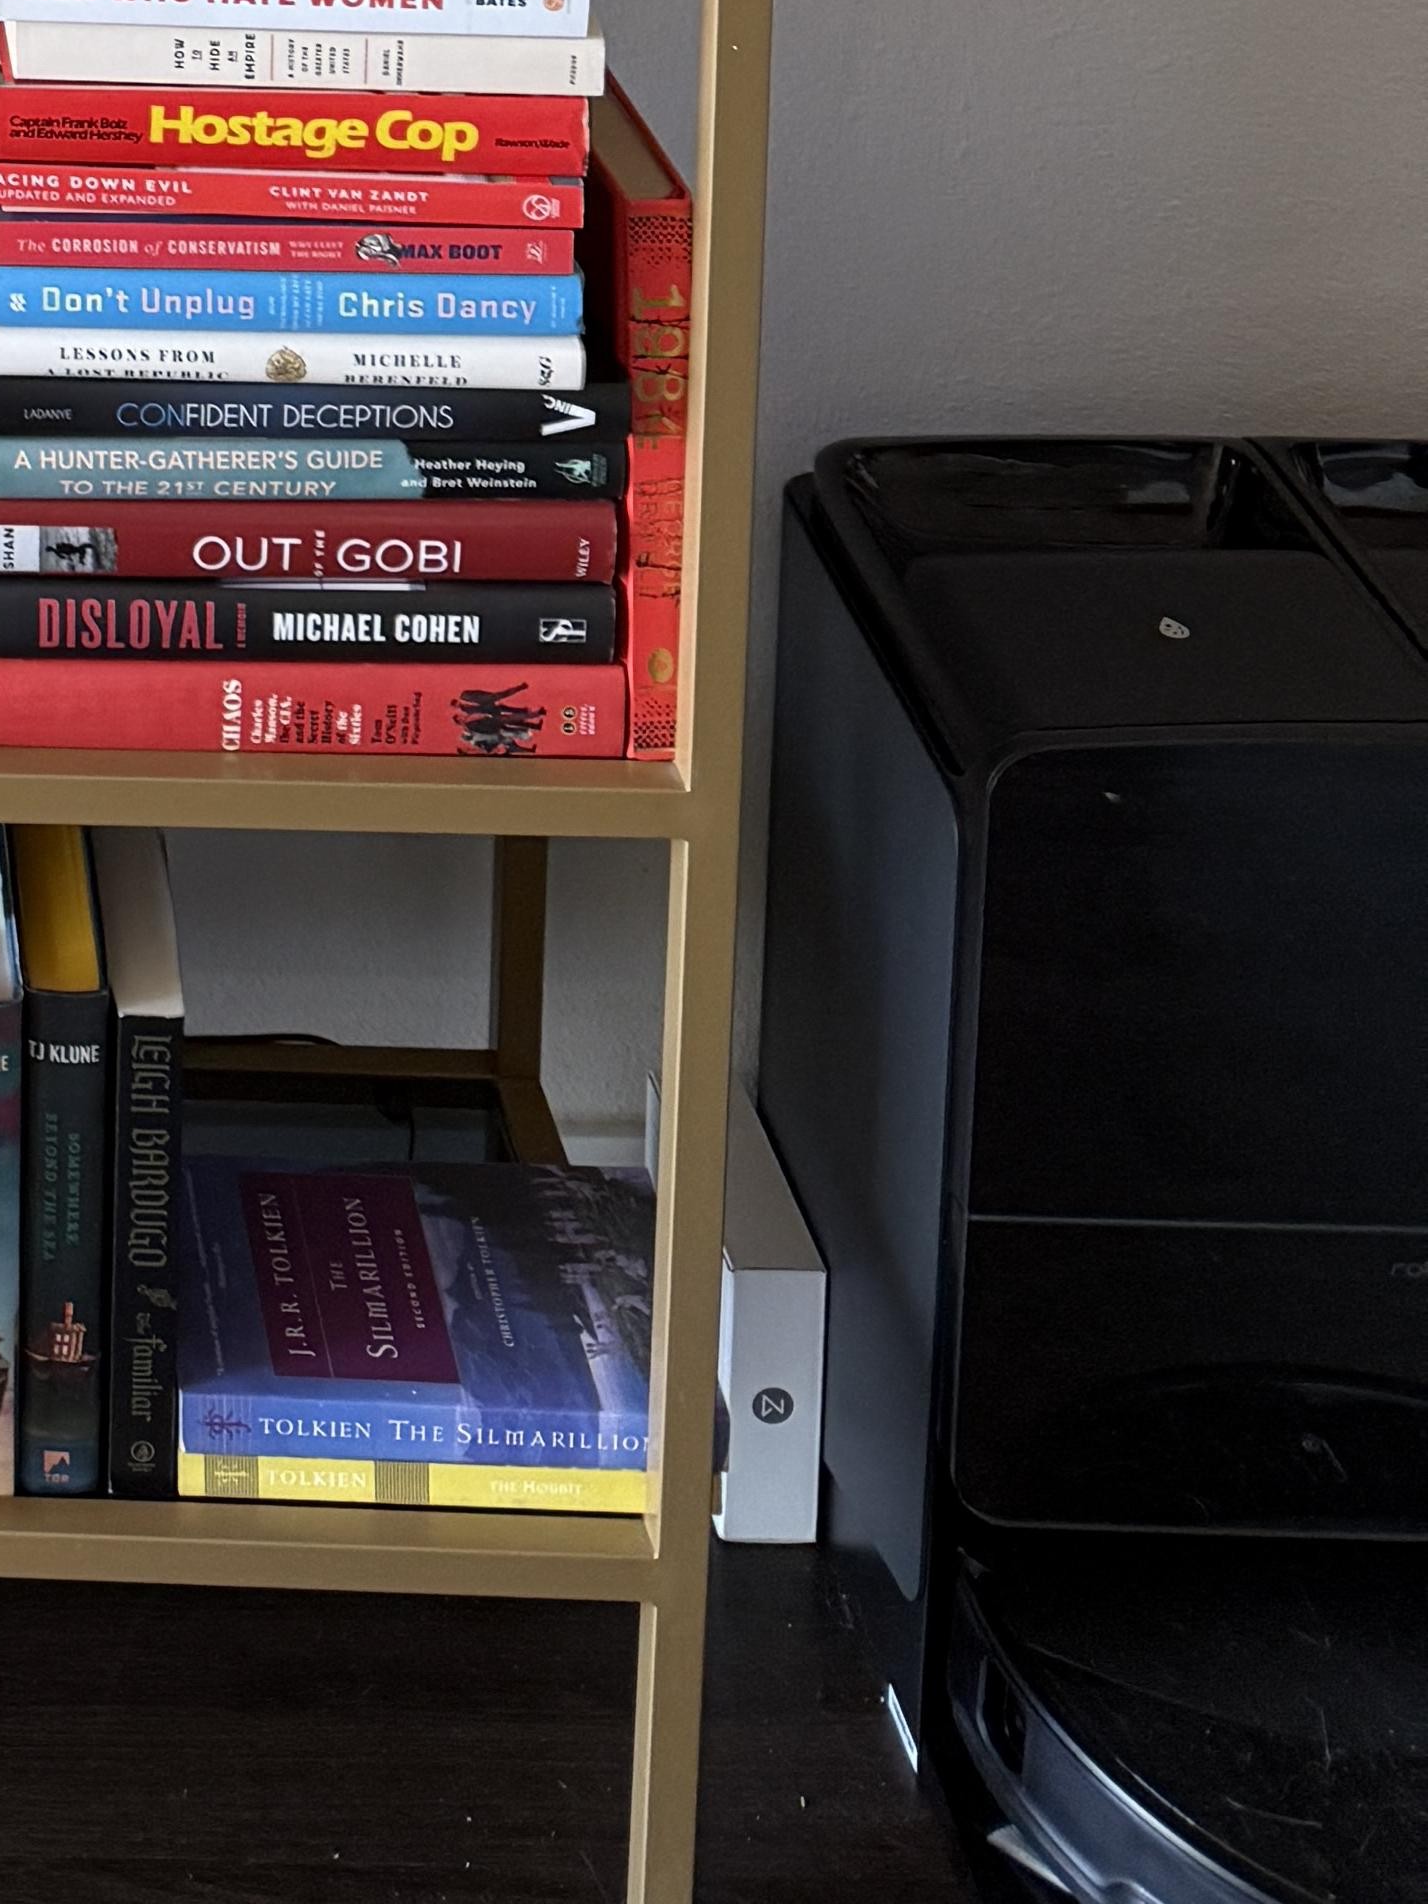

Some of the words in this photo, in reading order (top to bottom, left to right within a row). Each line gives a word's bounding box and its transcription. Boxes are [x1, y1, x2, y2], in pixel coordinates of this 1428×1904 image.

[149, 105, 366, 158] Hostage
[376, 110, 479, 162] Cop
[37, 599, 223, 651] DISLOYAL
[273, 612, 386, 643] MICHAEL
[394, 614, 480, 644] COHEN
[29, 1041, 45, 1063] TJ
[50, 1043, 99, 1064] KLUNE
[260, 1419, 372, 1438] TOLKIEN
